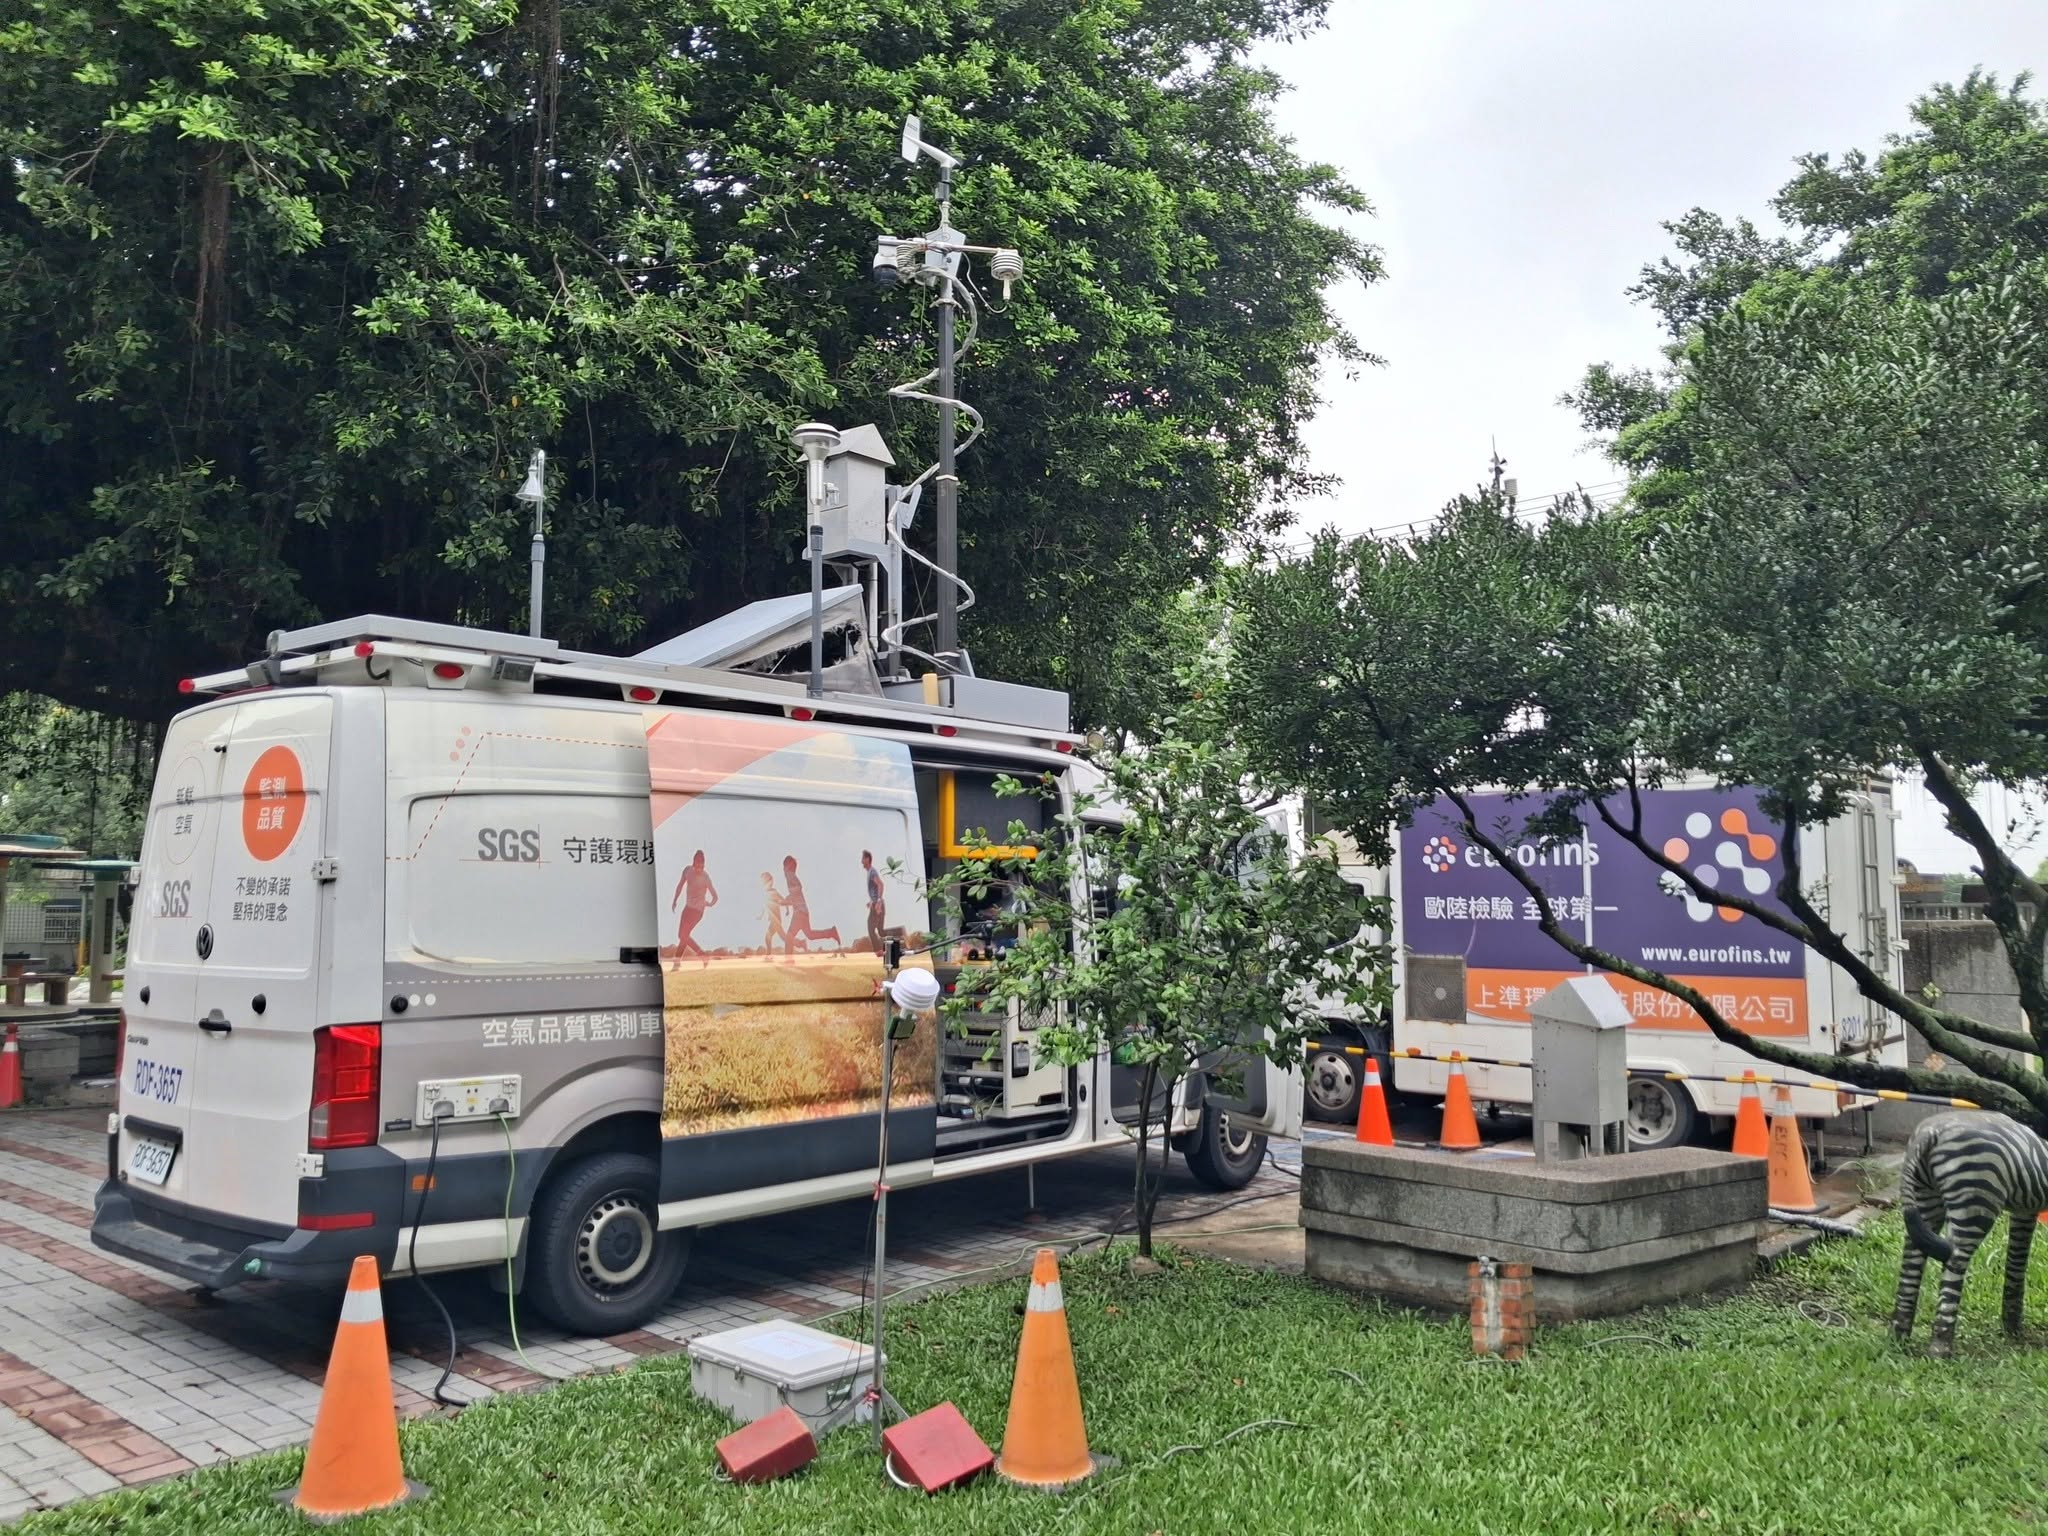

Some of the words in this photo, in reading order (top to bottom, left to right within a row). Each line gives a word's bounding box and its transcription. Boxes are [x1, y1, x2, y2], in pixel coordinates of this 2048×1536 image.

[259, 777, 286, 800] 監測
[257, 806, 285, 830] 品質
[478, 828, 540, 863] SGS
[1464, 834, 1599, 868] euofins
[161, 880, 192, 917] SGS
[235, 876, 292, 897] 不變的承諾
[232, 902, 288, 922] 堅持的理念
[1424, 896, 1514, 920] 歐陸檢驗
[1641, 945, 1791, 965] www.eurofins.tw
[482, 1011, 662, 1049] 空氣品質監測車
[134, 1058, 183, 1105] RDF-3657
